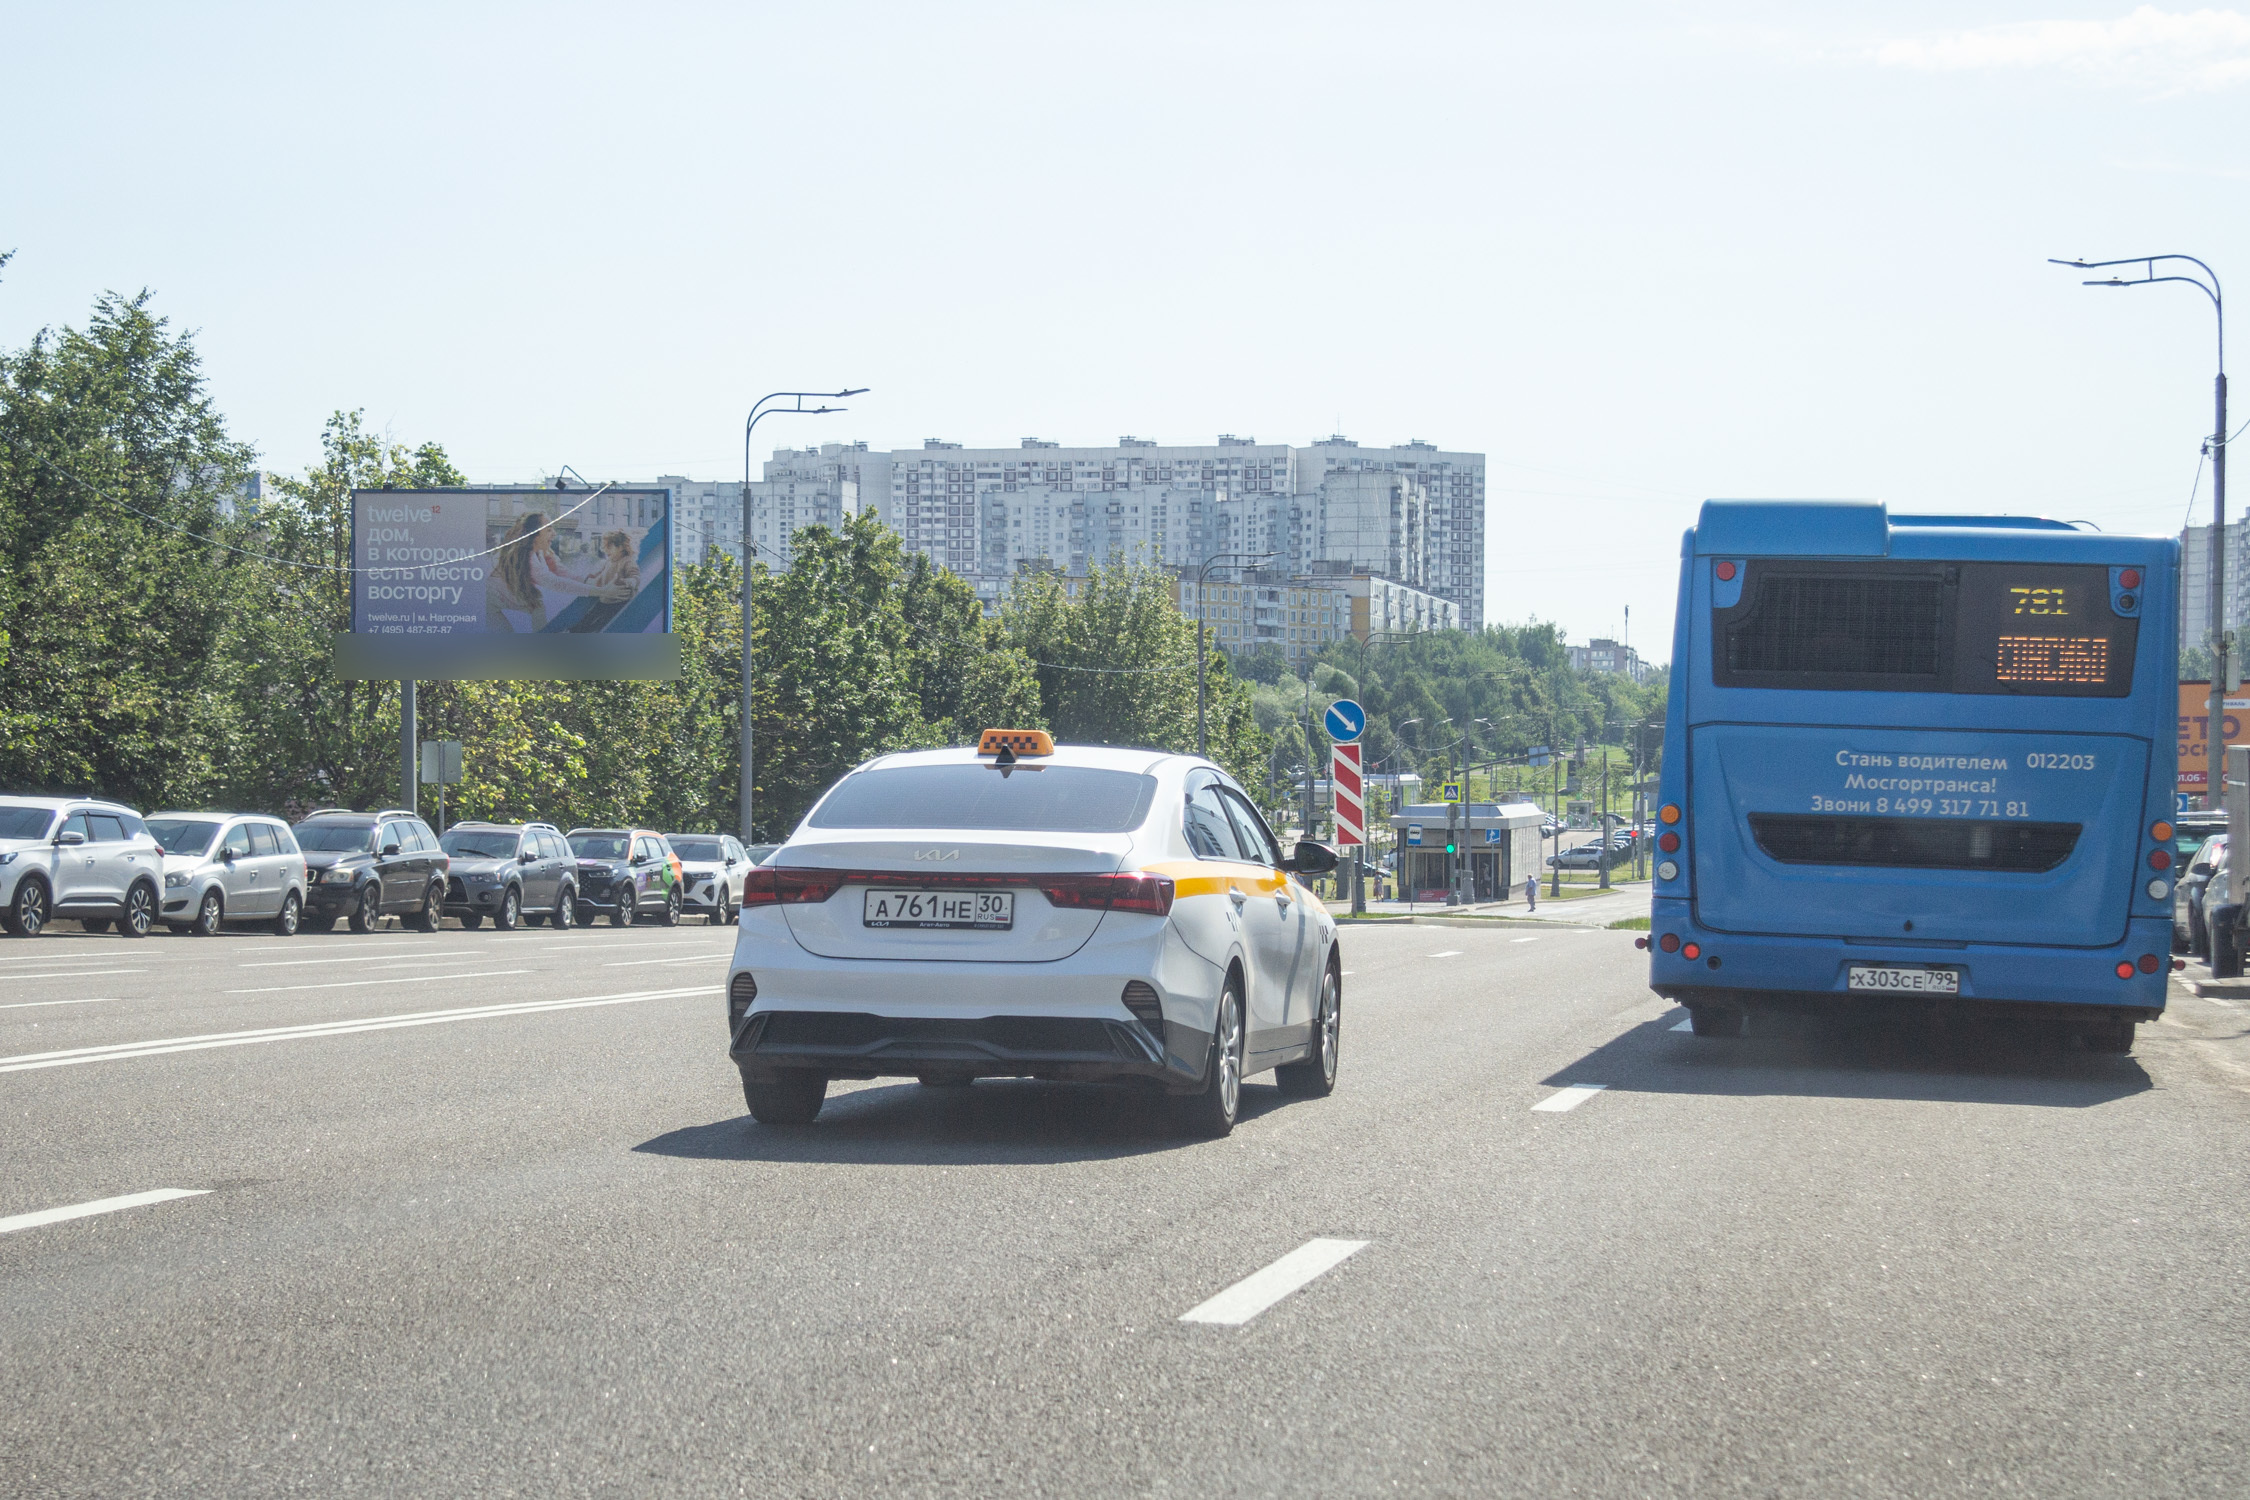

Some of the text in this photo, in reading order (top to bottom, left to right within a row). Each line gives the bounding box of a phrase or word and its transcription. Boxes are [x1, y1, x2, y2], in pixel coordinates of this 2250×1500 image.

[367, 504, 432, 522] twelve
[387, 548, 475, 564] котором
[368, 567, 484, 580] есть место
[368, 586, 463, 605] восторгу
[368, 613, 409, 622] twelve.ru
[430, 613, 477, 623] Нагорная
[368, 626, 452, 634] +7 (495) 487-87-87
[1997, 636, 2107, 682] СПАСИБО
[2178, 715, 2241, 740] ЕТО
[1836, 751, 2008, 771] Стань водителем
[2026, 753, 2095, 770] 012203
[1844, 774, 1997, 794] Мосгортранса!
[1811, 796, 2029, 817] Звони 8 499 317 71 81
[1926, 971, 1953, 986] 799
